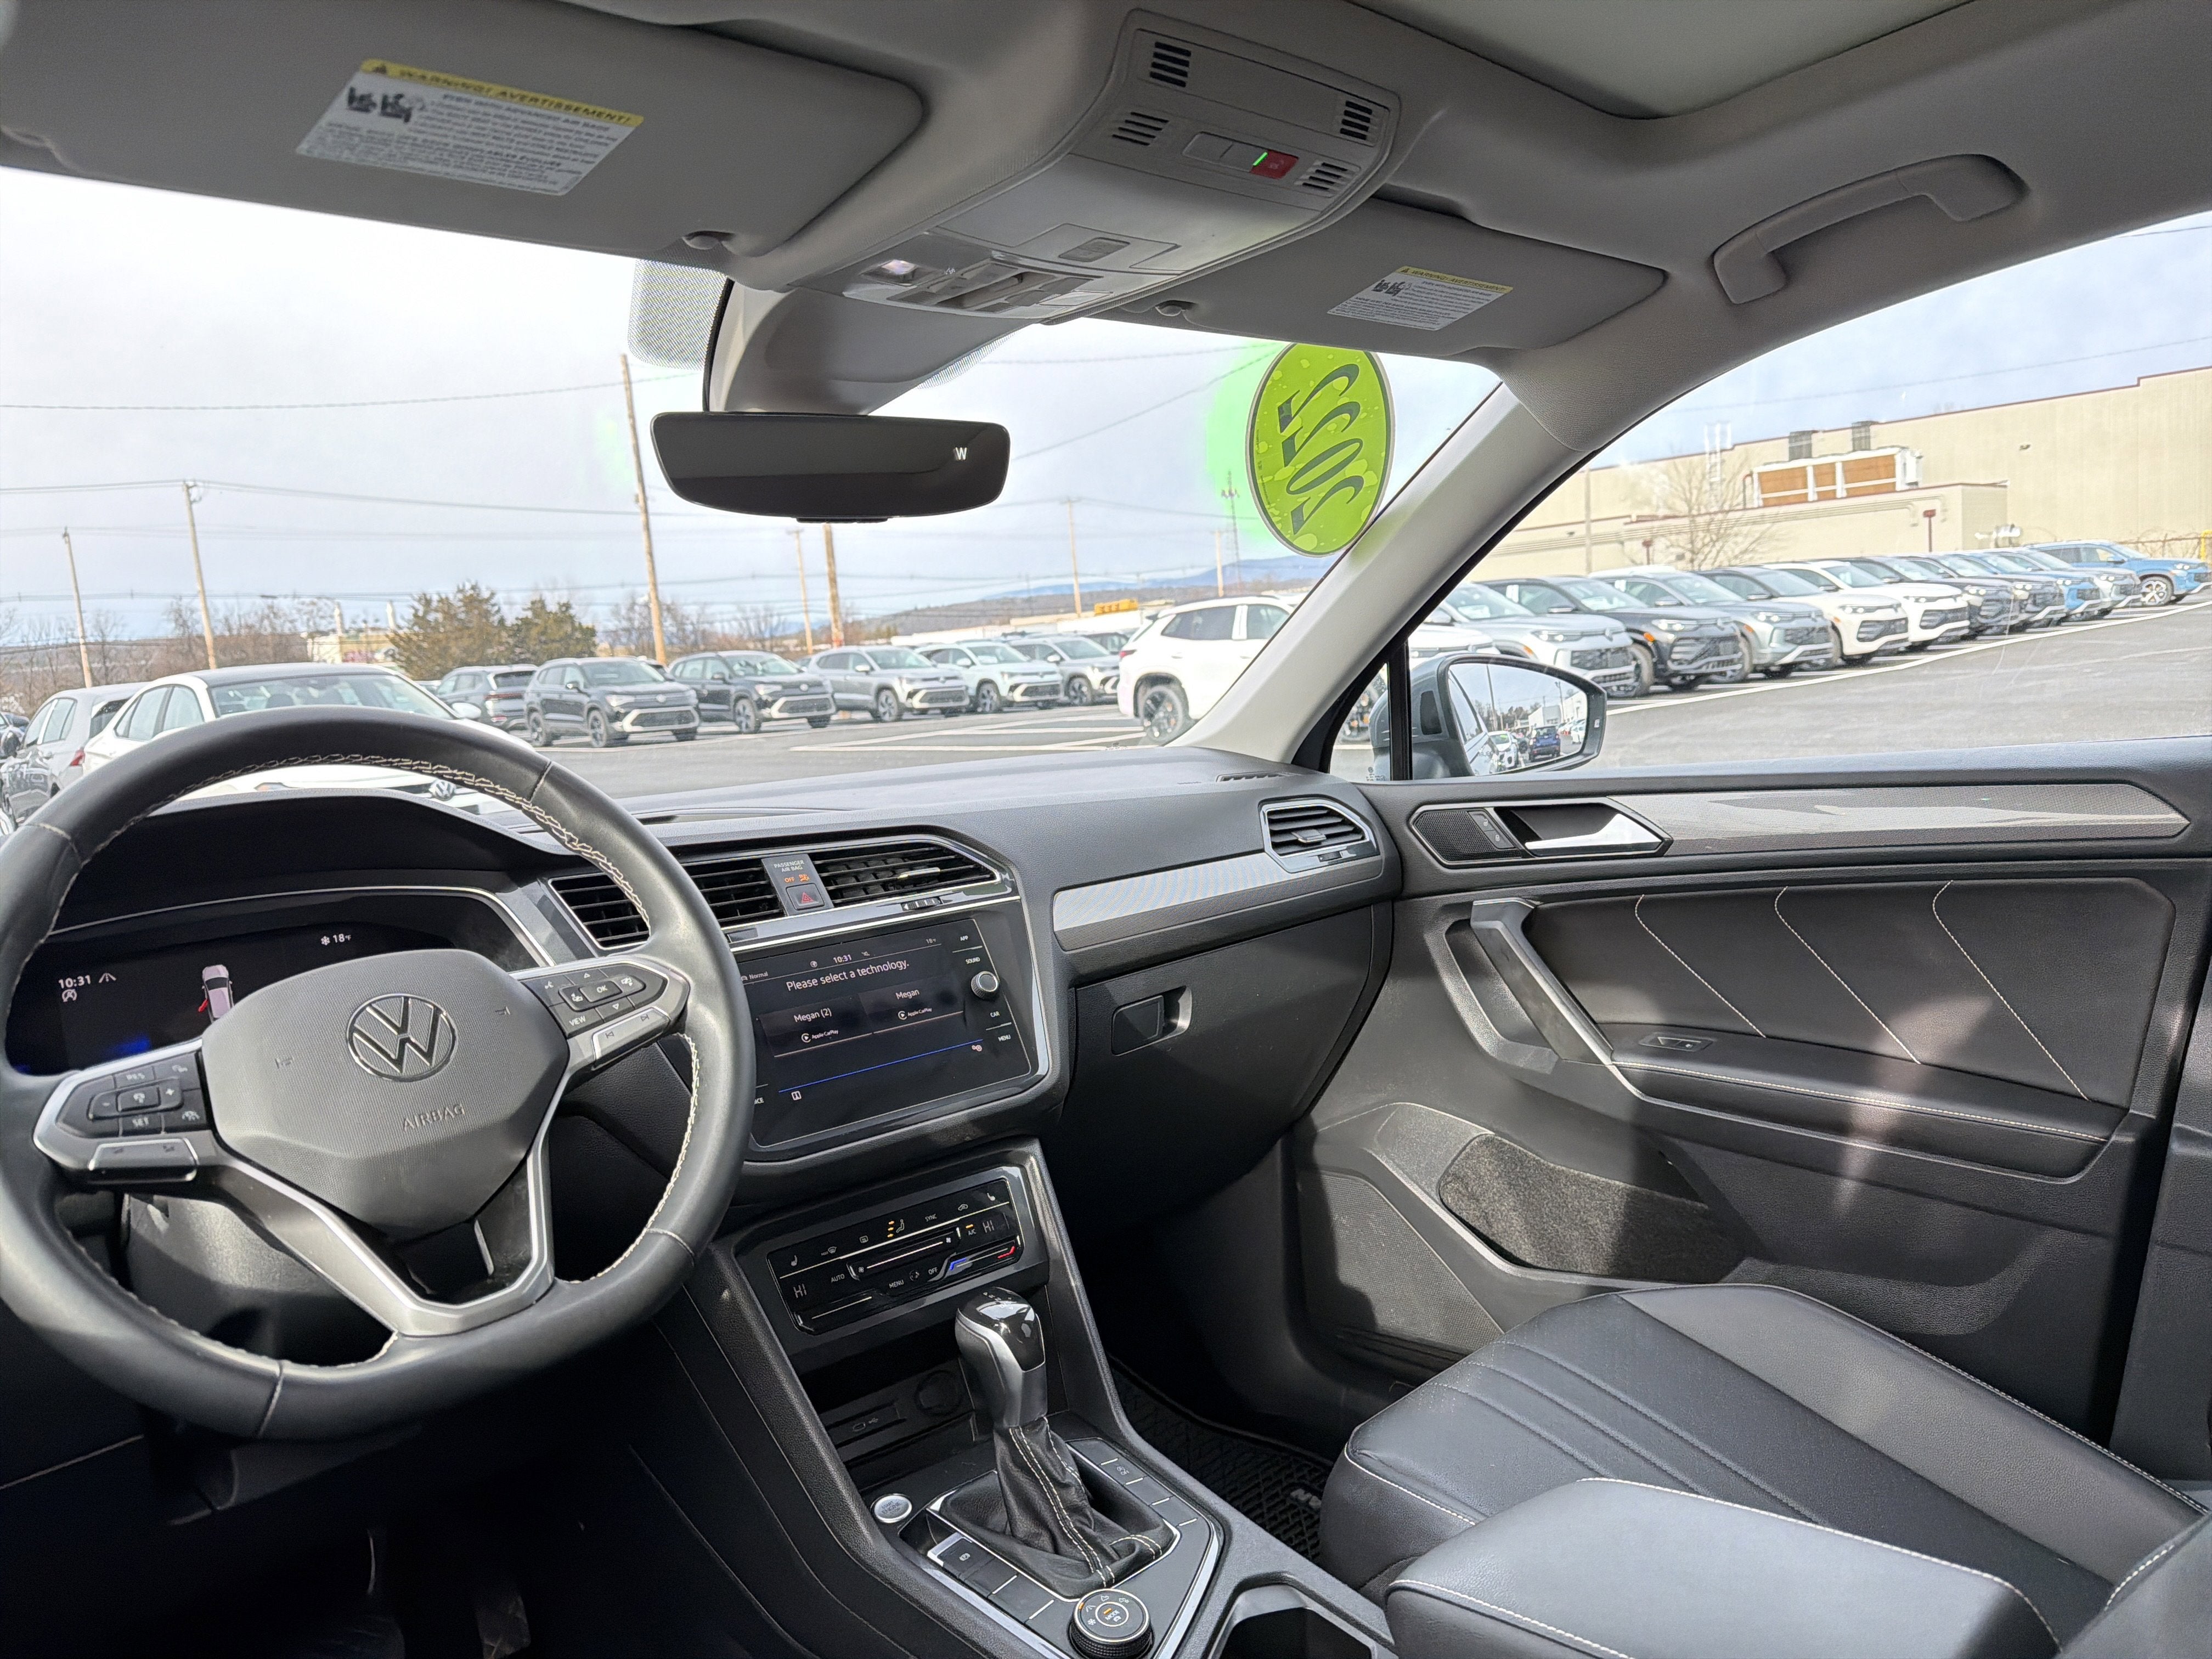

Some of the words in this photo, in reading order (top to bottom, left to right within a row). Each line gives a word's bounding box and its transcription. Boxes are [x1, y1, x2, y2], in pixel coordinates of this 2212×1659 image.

[955, 446, 968, 460] W
[774, 859, 805, 869] PASSENGER
[833, 953, 852, 963] 10:31
[749, 970, 768, 980] Normal
[786, 977, 819, 991] Please
[821, 970, 848, 985] select
[850, 971, 855, 979] a
[857, 959, 910, 978] technology.
[58, 974, 91, 989] 10:31
[596, 985, 608, 993] OK
[896, 989, 919, 1000] Megan
[794, 1011, 819, 1023] Megan
[821, 1008, 832, 1018] (2)
[907, 1009, 917, 1017] Apple
[569, 1015, 586, 1026] VIEW
[812, 1031, 823, 1040] Apple
[403, 1103, 465, 1132] AIRBAG
[925, 1214, 937, 1222] SYNC
[928, 1267, 938, 1275] OFF
[831, 1273, 845, 1283] AUTO
[889, 1279, 904, 1289] MENU
[1104, 1610, 1120, 1621] MODE
